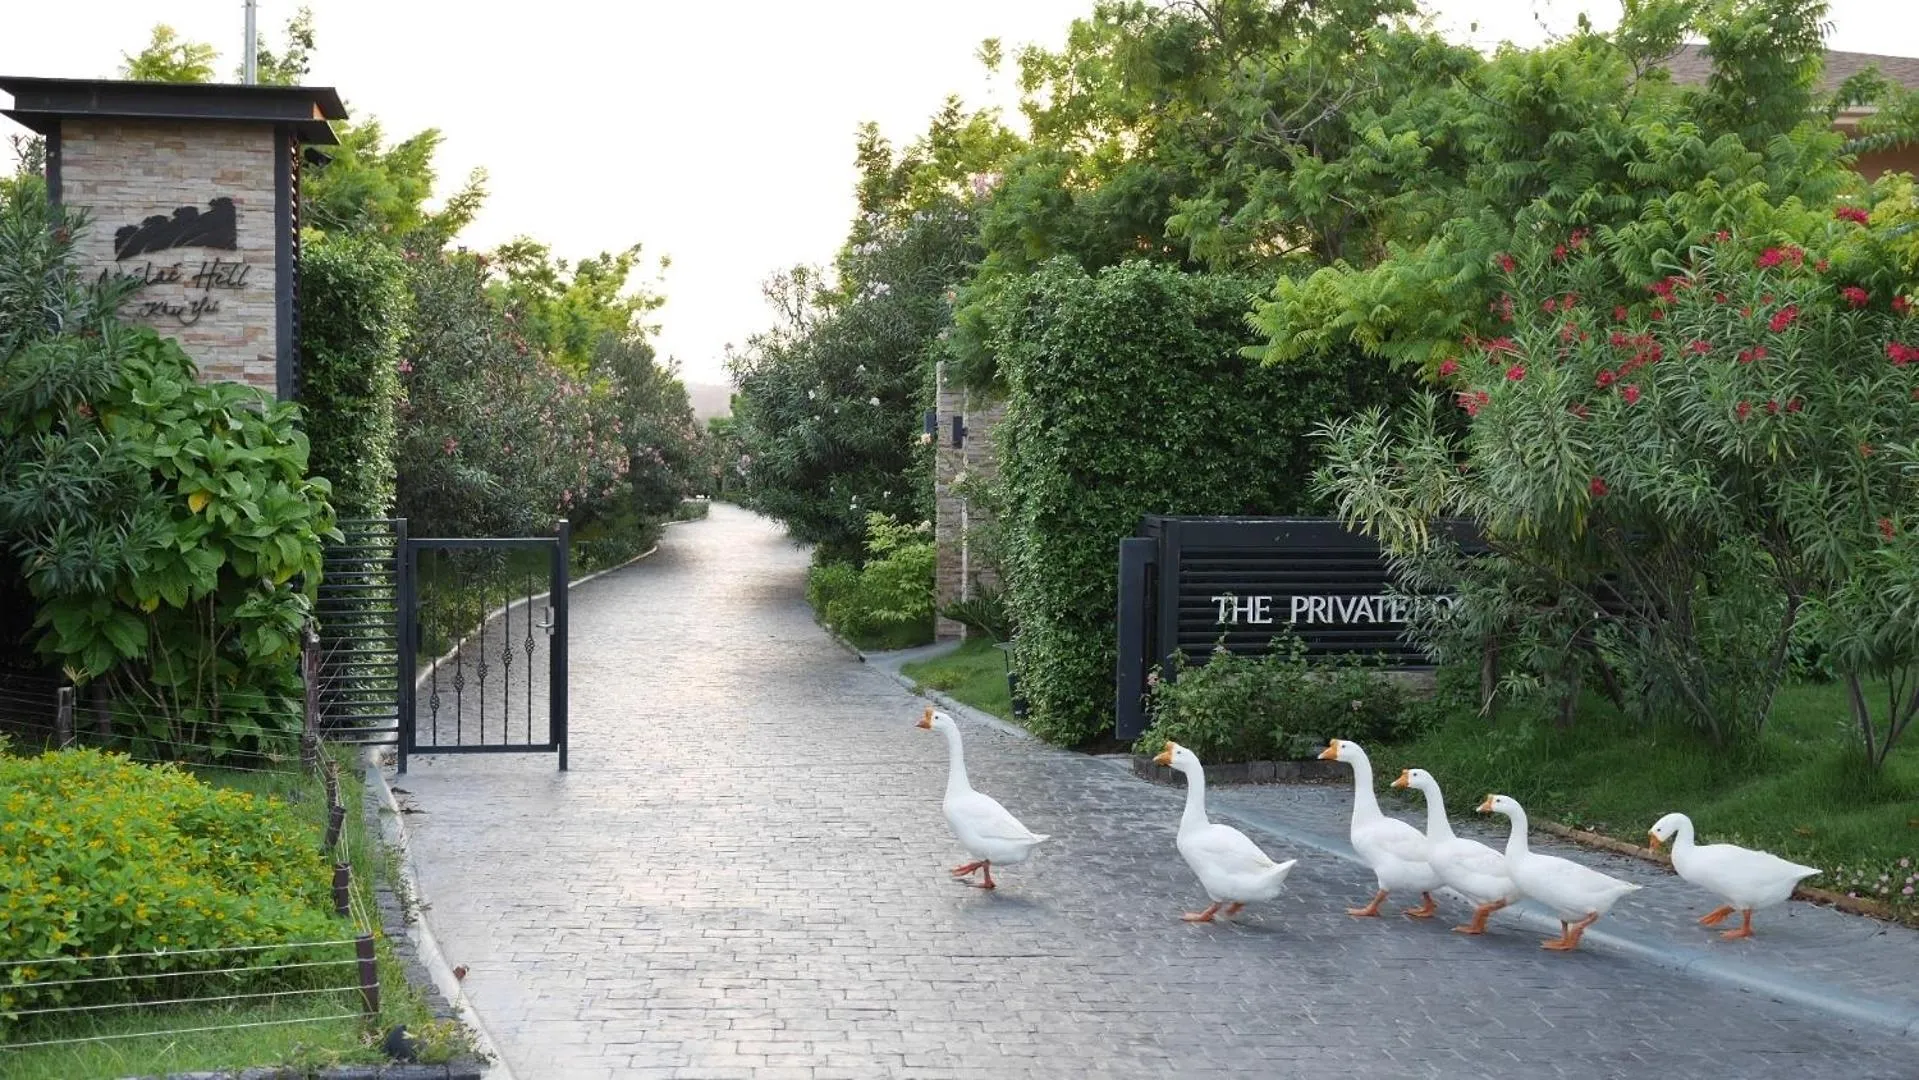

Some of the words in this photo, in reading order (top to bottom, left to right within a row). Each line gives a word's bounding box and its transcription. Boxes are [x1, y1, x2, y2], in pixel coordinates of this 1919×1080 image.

[193, 258, 251, 291] Hill
[1211, 595, 1273, 624] THE
[1291, 595, 1409, 623] PRIVATE
